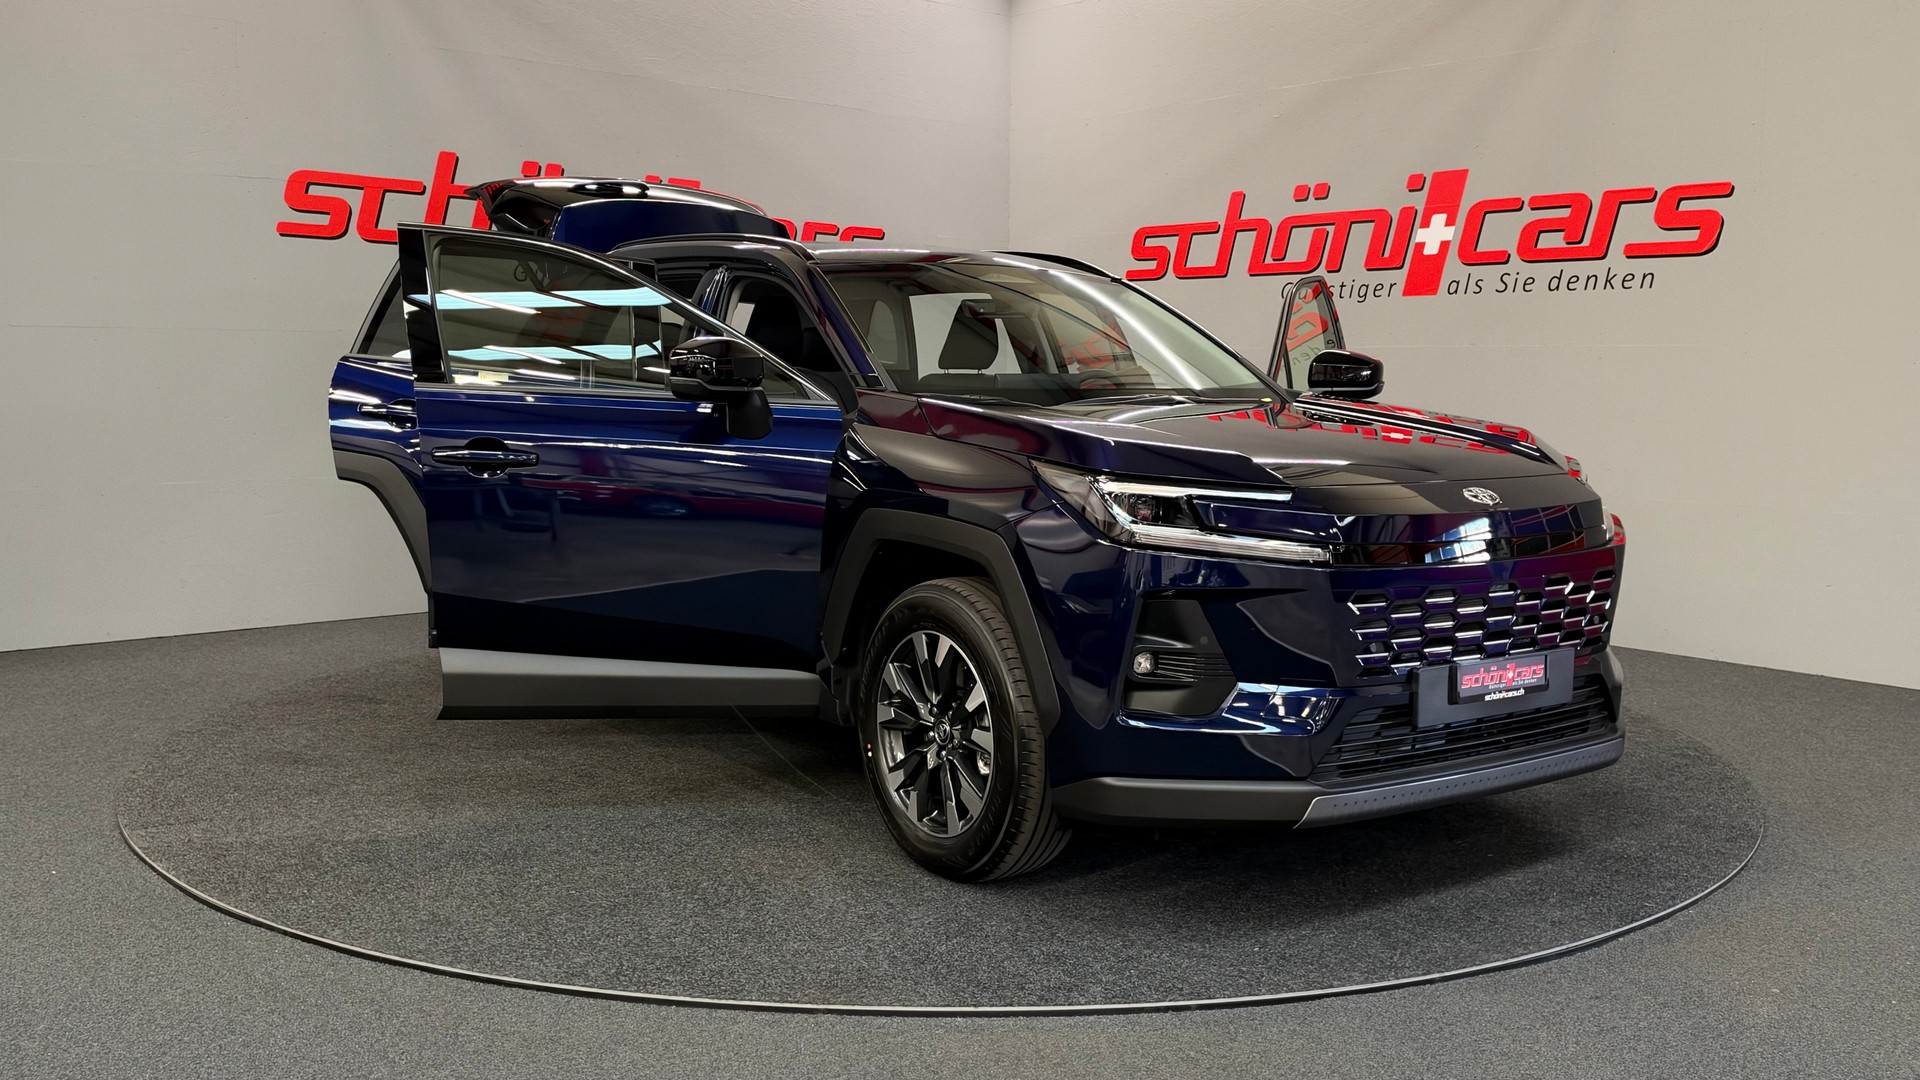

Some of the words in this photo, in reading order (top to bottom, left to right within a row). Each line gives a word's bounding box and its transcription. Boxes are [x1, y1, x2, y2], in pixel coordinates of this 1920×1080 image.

[1447, 273, 1484, 295] als
[1495, 271, 1536, 293] Sie
[1547, 267, 1655, 292] denken
